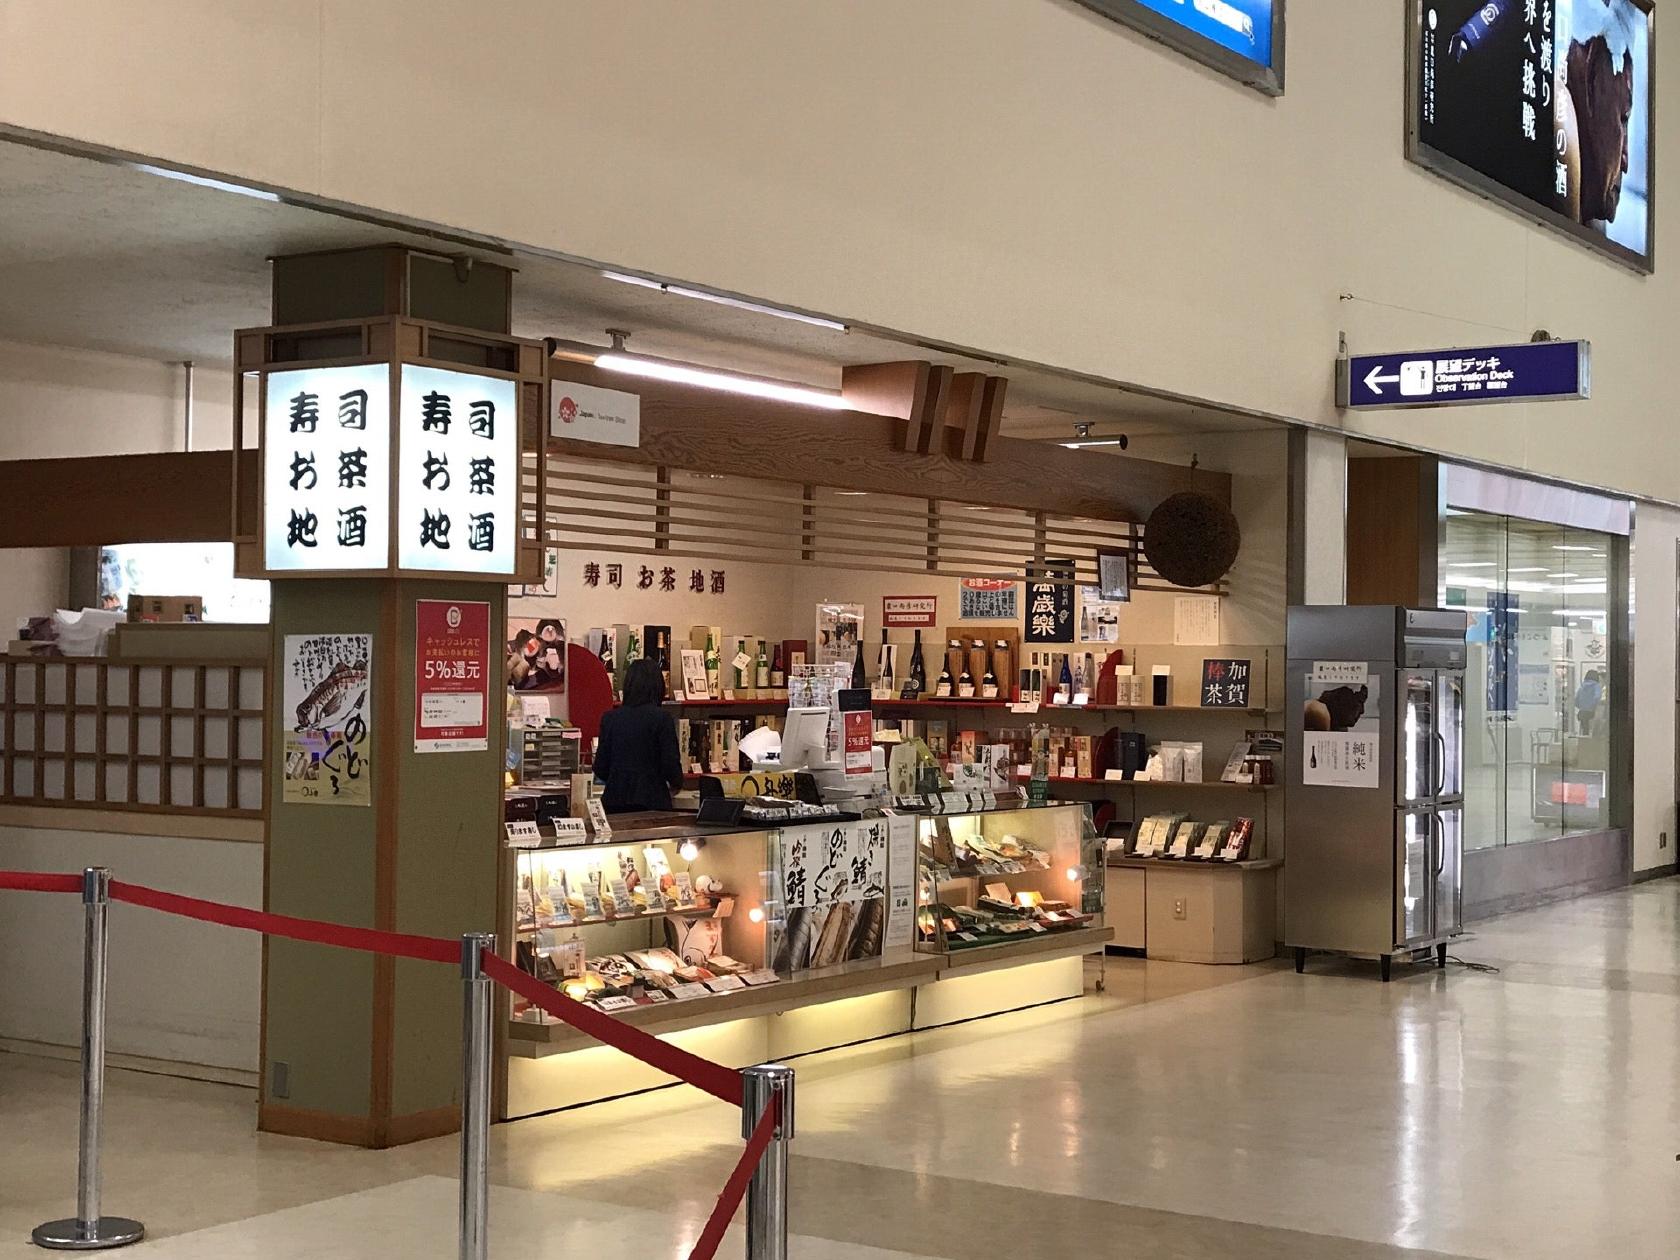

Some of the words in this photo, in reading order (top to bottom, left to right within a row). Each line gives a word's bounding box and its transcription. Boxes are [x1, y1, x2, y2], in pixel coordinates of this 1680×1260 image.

[1435, 372, 1488, 383] Observation
[1489, 370, 1514, 380] Deck
[1436, 357, 1500, 373] 展望デッキ
[290, 389, 368, 433] 寿司
[421, 390, 496, 440] 寿司
[289, 446, 368, 491] お茶
[422, 450, 496, 496] お茶
[287, 505, 367, 549] 地酒
[420, 507, 495, 553] 地酒
[584, 561, 624, 589] 寿司
[637, 564, 677, 592] お茶
[688, 569, 726, 595] 地酒
[426, 637, 481, 647] キャッシュレスで
[425, 660, 480, 679] 5%還元
[1225, 662, 1247, 704] 加賀
[1352, 741, 1366, 771] 純米
